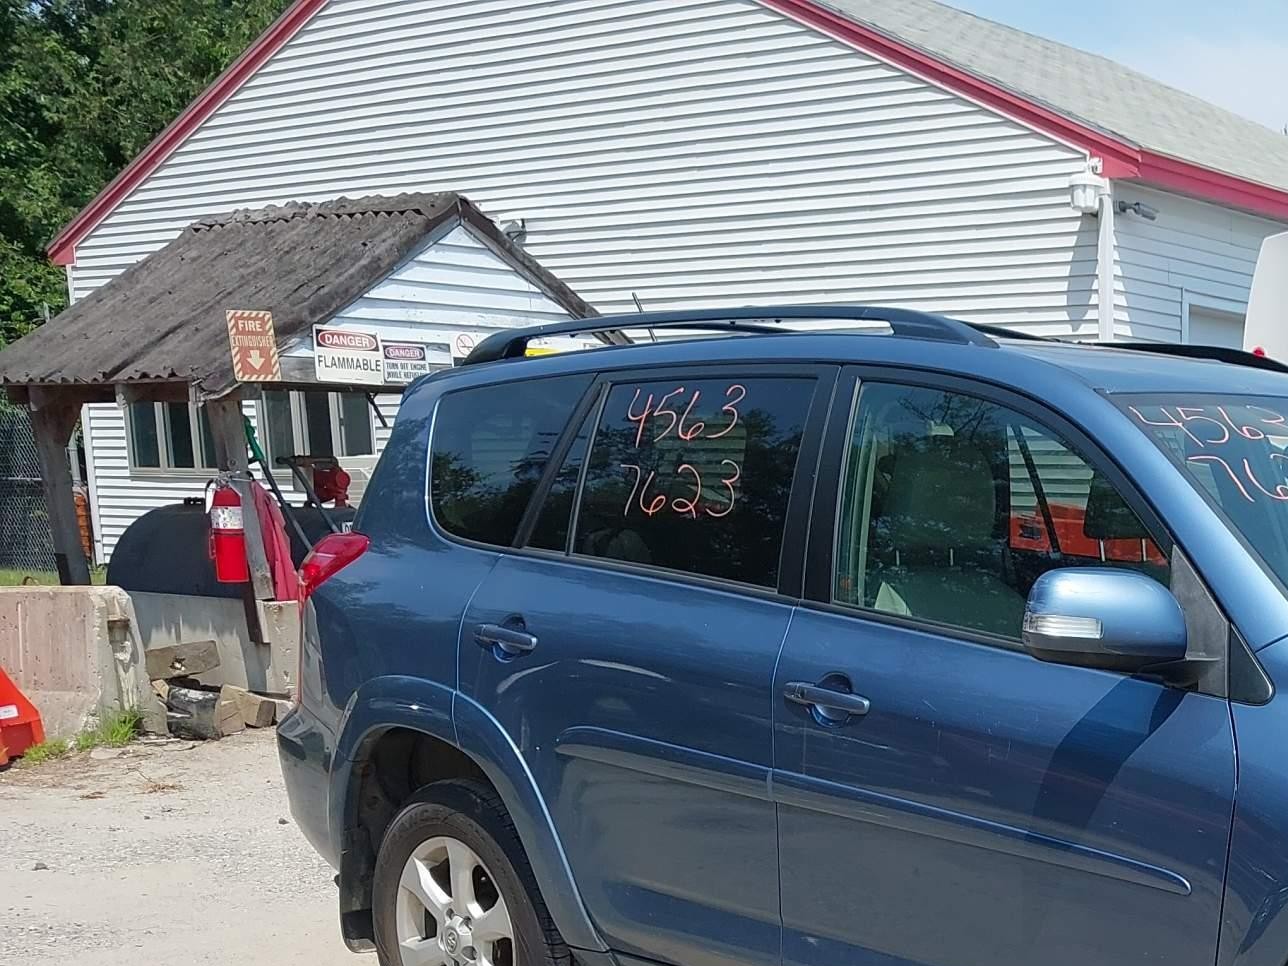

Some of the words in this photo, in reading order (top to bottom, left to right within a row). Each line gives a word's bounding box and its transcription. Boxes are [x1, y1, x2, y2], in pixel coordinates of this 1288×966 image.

[238, 320, 263, 332] FIRE
[231, 335, 275, 347] EXTINGUISHER
[325, 334, 370, 347] DANGER
[389, 348, 420, 358] DANGER
[318, 355, 381, 372] FLAMMABLE
[627, 384, 746, 449] 4563
[620, 459, 740, 519] 7623
